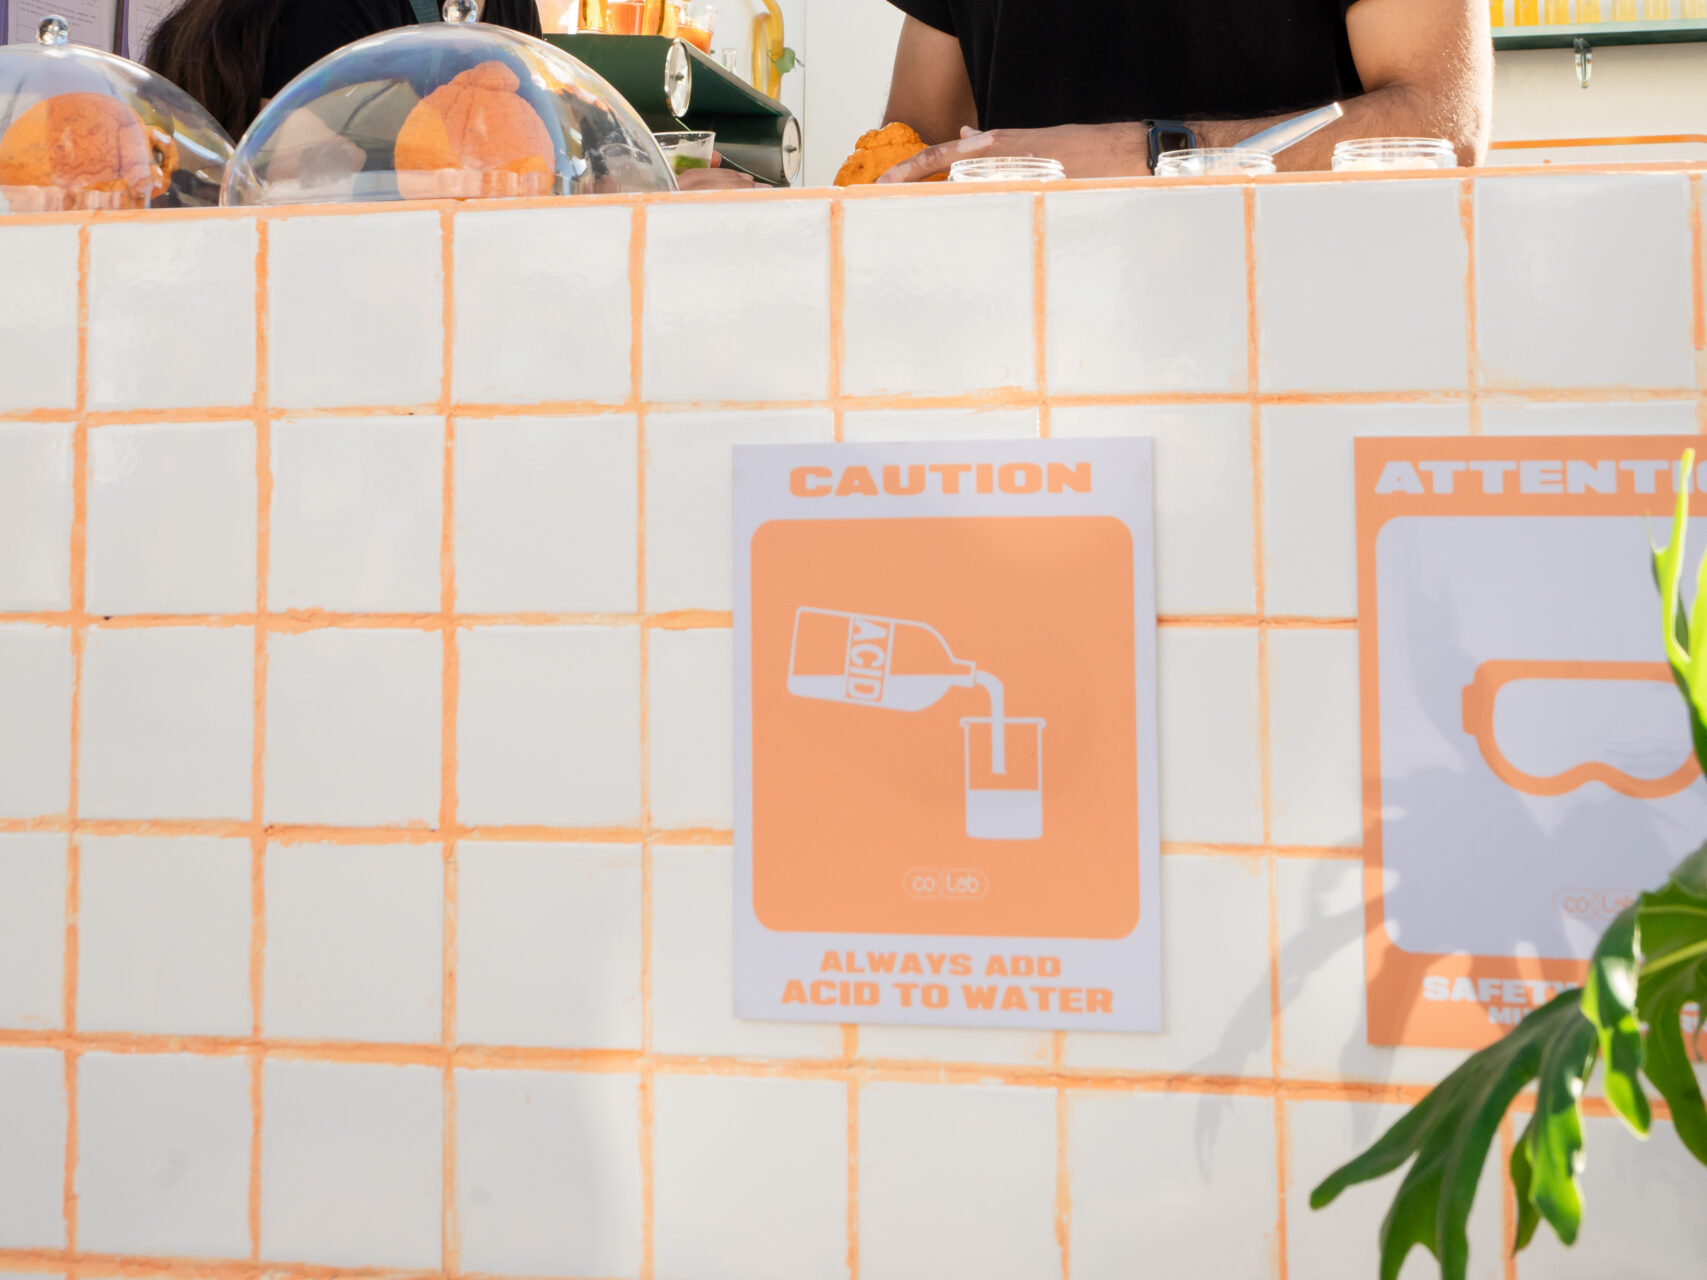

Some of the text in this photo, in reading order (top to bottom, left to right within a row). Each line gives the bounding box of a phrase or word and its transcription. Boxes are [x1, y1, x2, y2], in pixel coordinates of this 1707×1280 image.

[789, 462, 1092, 498] CAUTION
[1375, 459, 1707, 494] ATTENTI
[848, 615, 888, 700] ACID
[819, 950, 1062, 978] ALWAYS ADD
[781, 978, 1114, 1014] ACID TO WATER
